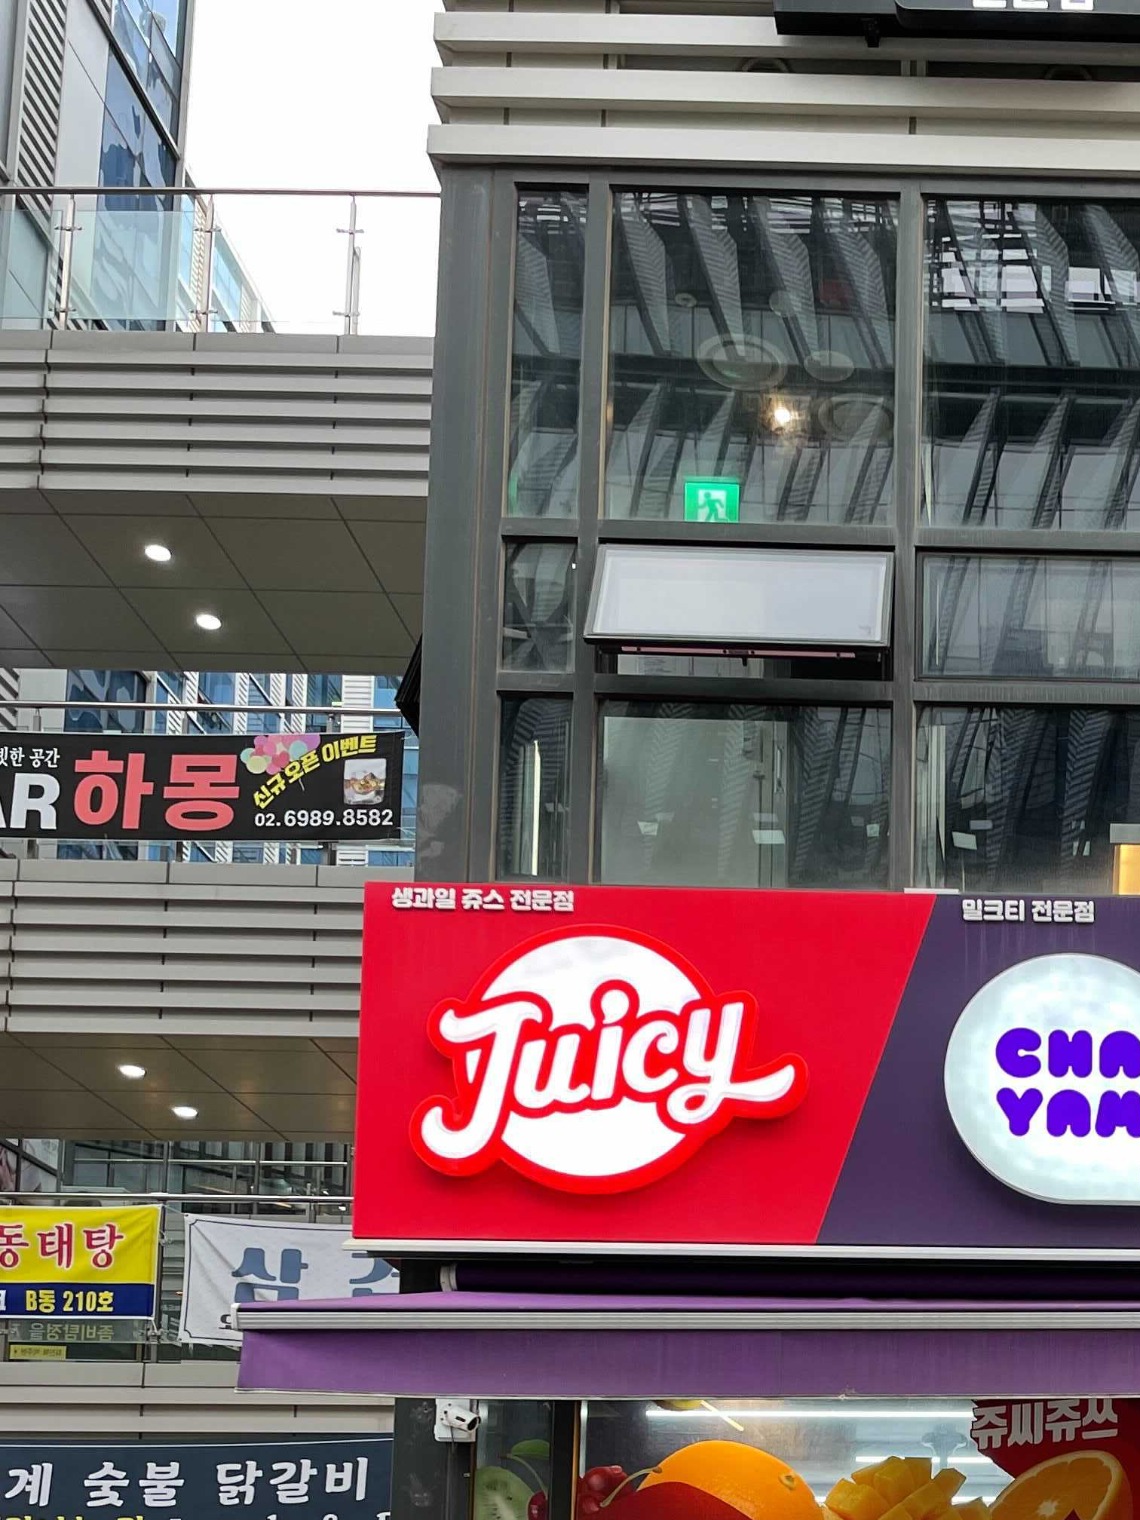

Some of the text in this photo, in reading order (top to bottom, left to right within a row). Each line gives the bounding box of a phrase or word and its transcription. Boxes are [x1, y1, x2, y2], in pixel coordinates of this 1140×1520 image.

[29, 747, 60, 768] 공간
[253, 735, 378, 809] 신규 오픈 이벤트
[73, 749, 240, 831] 하몽
[254, 809, 393, 828] 02.6989.8582
[392, 887, 575, 912] 생과일 쥬스 전문점
[962, 898, 1095, 924] 밀크티 전문점
[420, 985, 797, 1160] Juicy
[0, 1222, 126, 1270] 동태탕
[25, 1290, 55, 1313] B동
[62, 1289, 115, 1313] 210호
[83, 1461, 185, 1508] 숯불
[216, 1456, 369, 1507] 닭갈비
